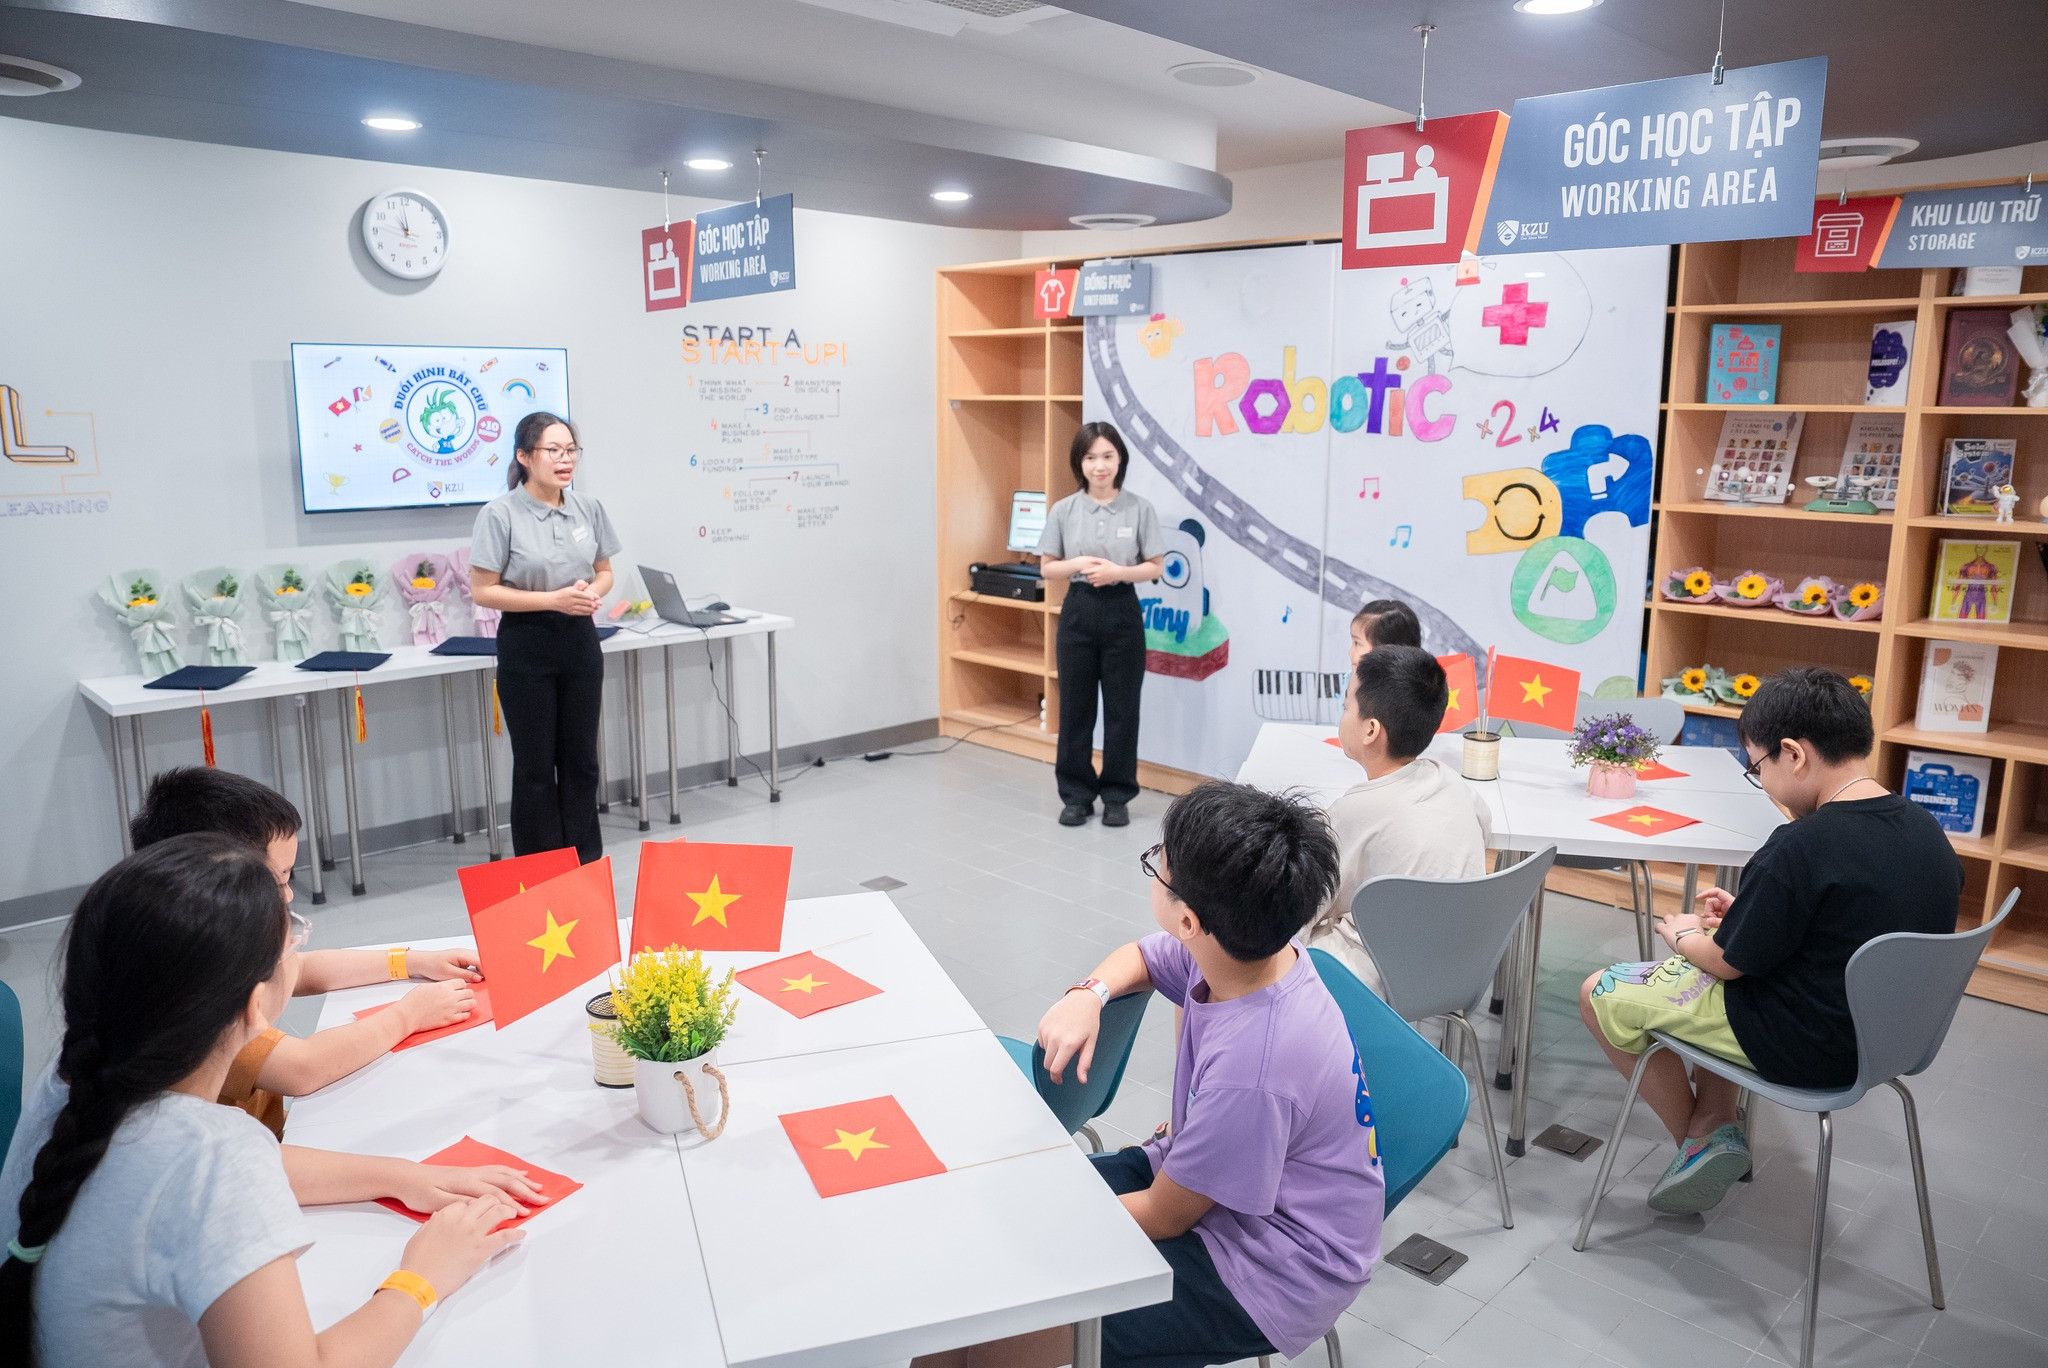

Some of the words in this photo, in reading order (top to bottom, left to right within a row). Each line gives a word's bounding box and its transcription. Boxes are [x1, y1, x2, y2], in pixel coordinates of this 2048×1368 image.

[1563, 112, 1631, 168] GÓC
[1640, 108, 1713, 167] HỌC
[1725, 90, 1802, 158] TẬP
[1561, 175, 1691, 218] WORKING
[1701, 167, 1778, 207] AREA
[387, 201, 396, 209] 11
[400, 198, 410, 206] 12
[420, 204, 424, 212] 1
[1911, 204, 1952, 227] KHU
[1955, 201, 1995, 225] LƯU
[2000, 194, 2042, 223] TRỮ
[376, 212, 386, 220] 10
[432, 216, 438, 224] 2
[373, 227, 379, 236] 9
[698, 224, 720, 256] GÓC
[722, 222, 744, 255] HỌC
[746, 213, 770, 251] TẬP
[1521, 222, 1550, 236] KZU
[436, 232, 442, 240] 3
[378, 242, 384, 250] 8
[1908, 232, 1977, 252] STORAGE
[433, 246, 438, 254] 4
[391, 254, 396, 262] 7
[422, 257, 428, 266] 5
[406, 260, 411, 269] 6
[700, 259, 741, 284] WORKING
[743, 255, 767, 277] AREA
[683, 325, 771, 347] START
[784, 329, 801, 348] A
[783, 375, 790, 387] 2
[762, 403, 769, 415] 3
[406, 442, 433, 464] CATCH
[454, 439, 480, 464] WORDS
[690, 454, 698, 467] 6
[793, 471, 799, 482] 7
[445, 483, 464, 493] KZU
[733, 489, 765, 497] FOLLOW
[0, 500, 109, 517] EARNING
[1139, 598, 1189, 644] Tiny
[1910, 793, 1959, 806] BUSINESS
